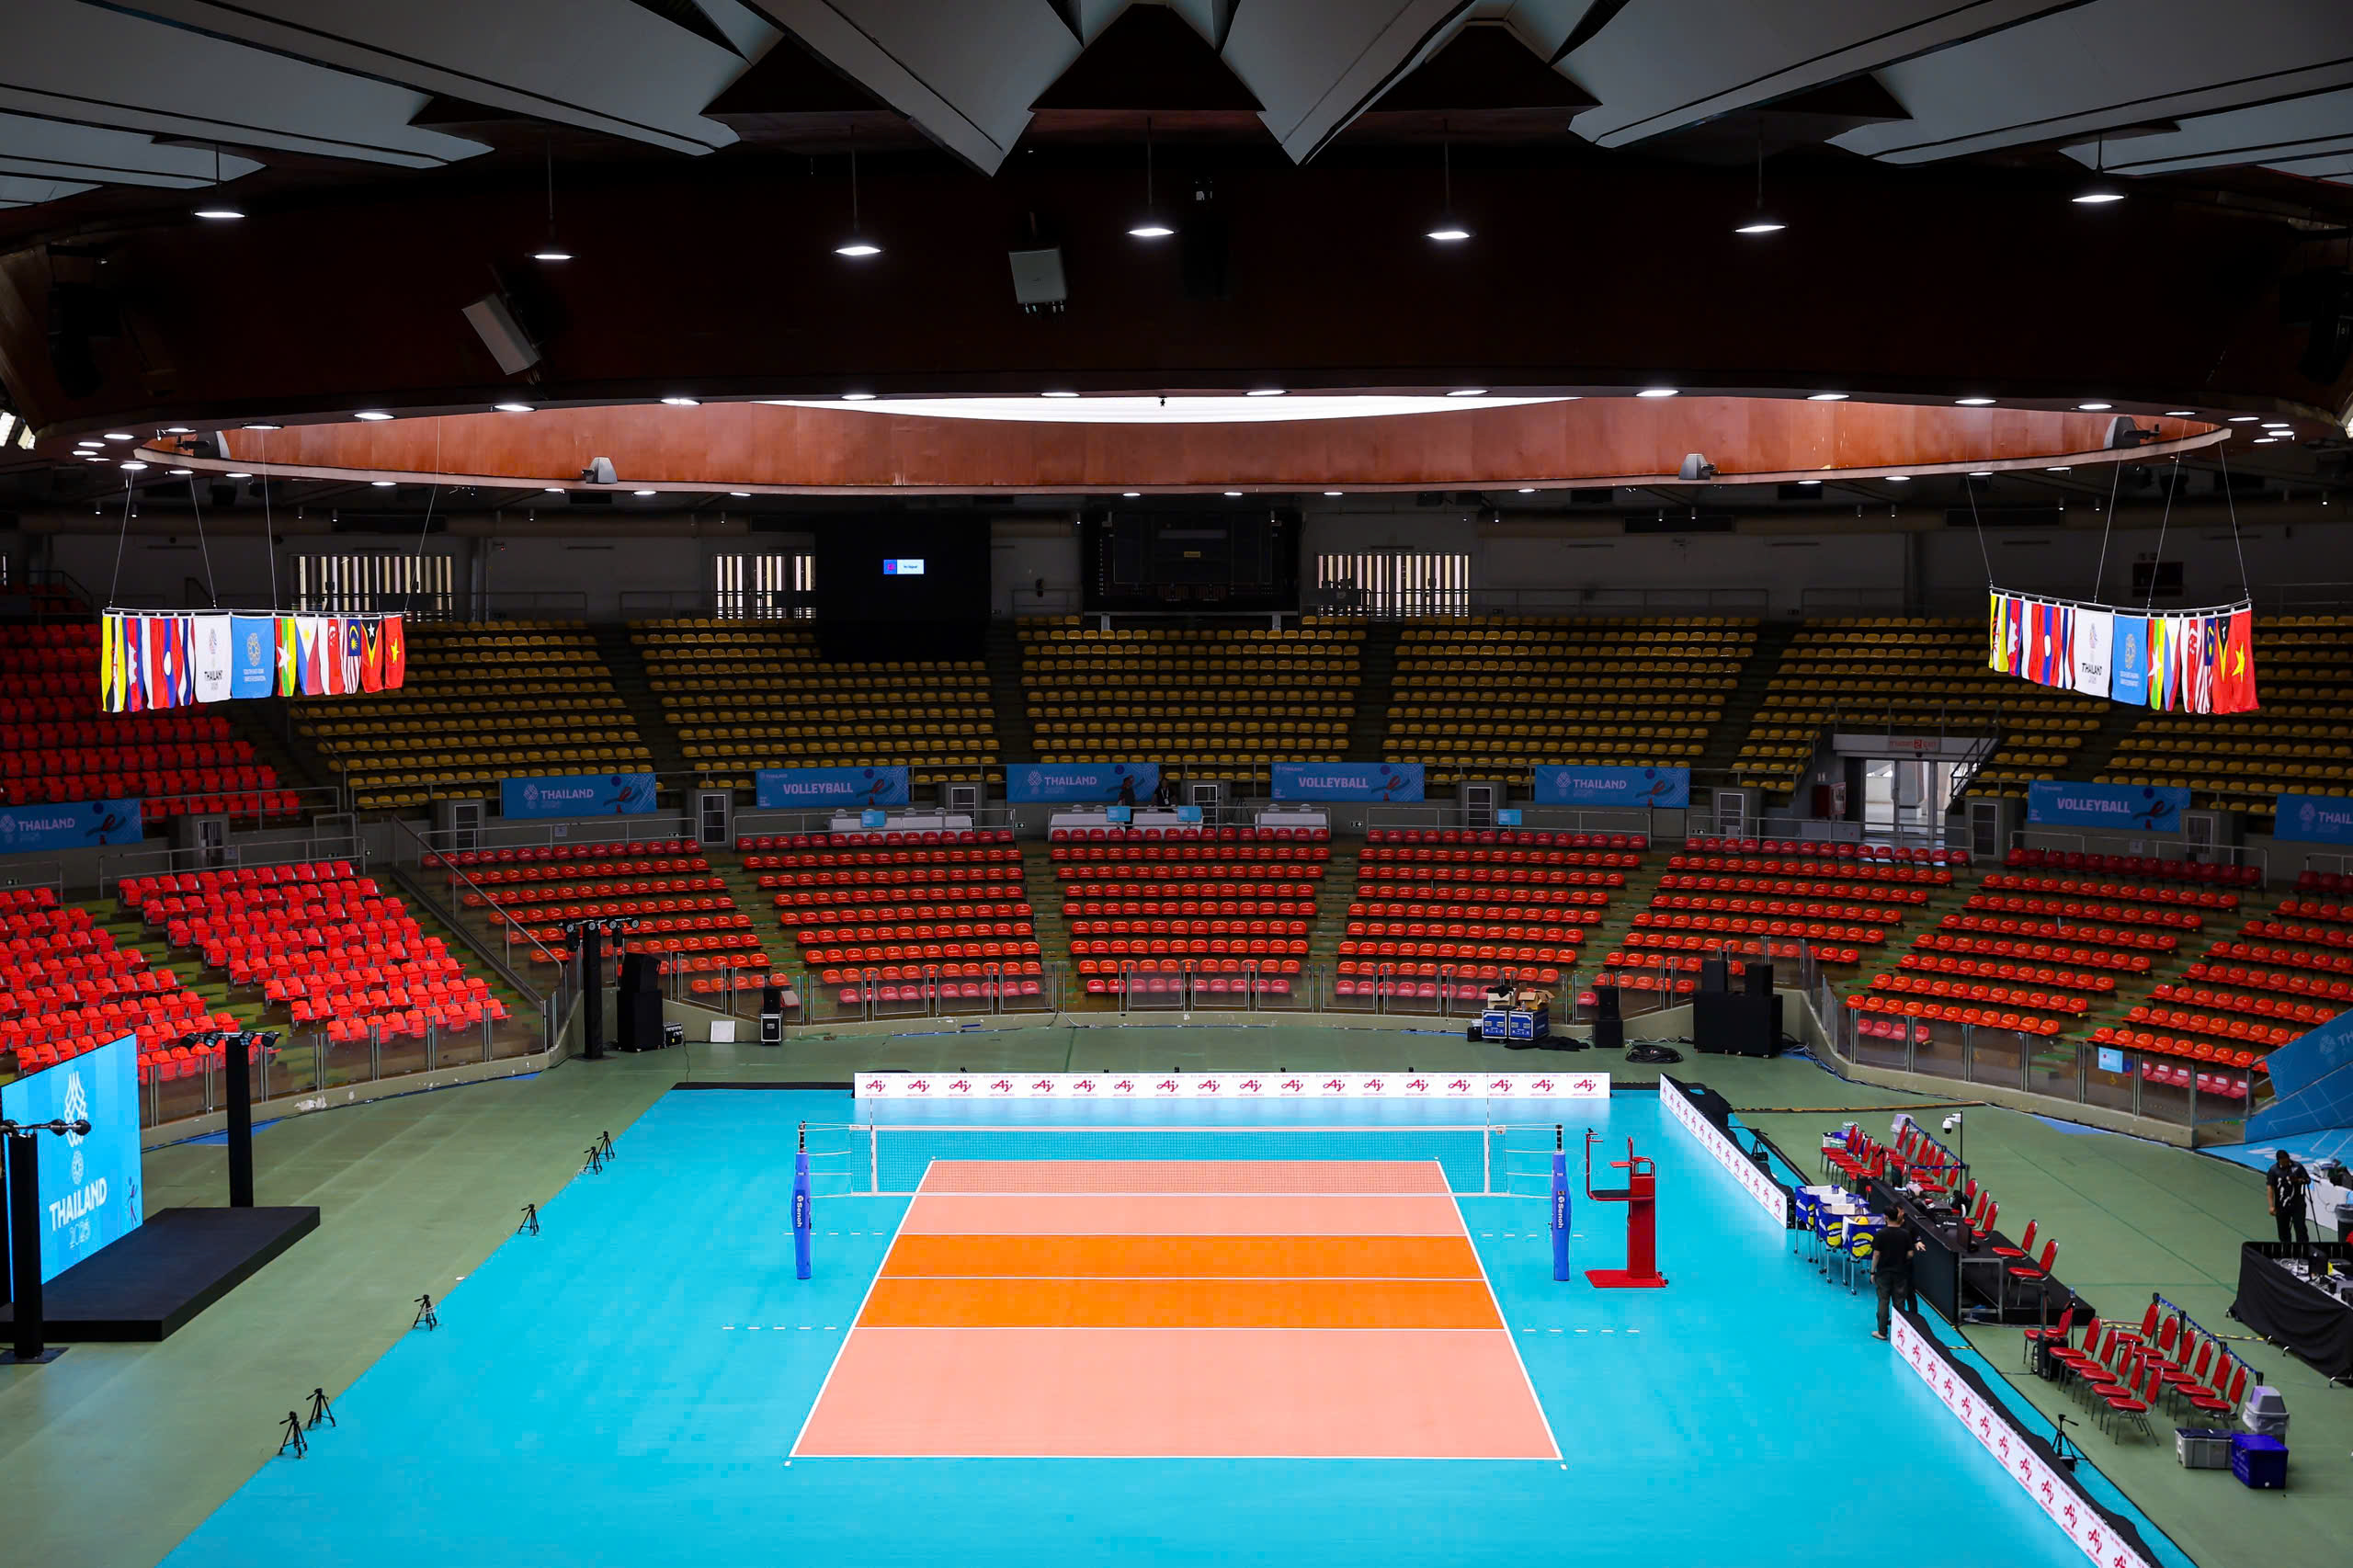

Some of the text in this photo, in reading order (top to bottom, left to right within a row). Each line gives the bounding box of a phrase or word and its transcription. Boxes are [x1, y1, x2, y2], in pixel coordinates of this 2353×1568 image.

[1044, 776, 1097, 786] THAILAND
[1298, 777, 1368, 788] VOLLEYBALL
[1574, 778, 1627, 790] THAILAND
[783, 782, 853, 794] VOLLEYBALL
[540, 789, 595, 800] THAILAND
[2057, 798, 2131, 813] VOLLEYBALL
[2317, 811, 2353, 824] THAIL
[17, 816, 76, 832] THAILAND
[49, 1177, 108, 1232] THAILAND
